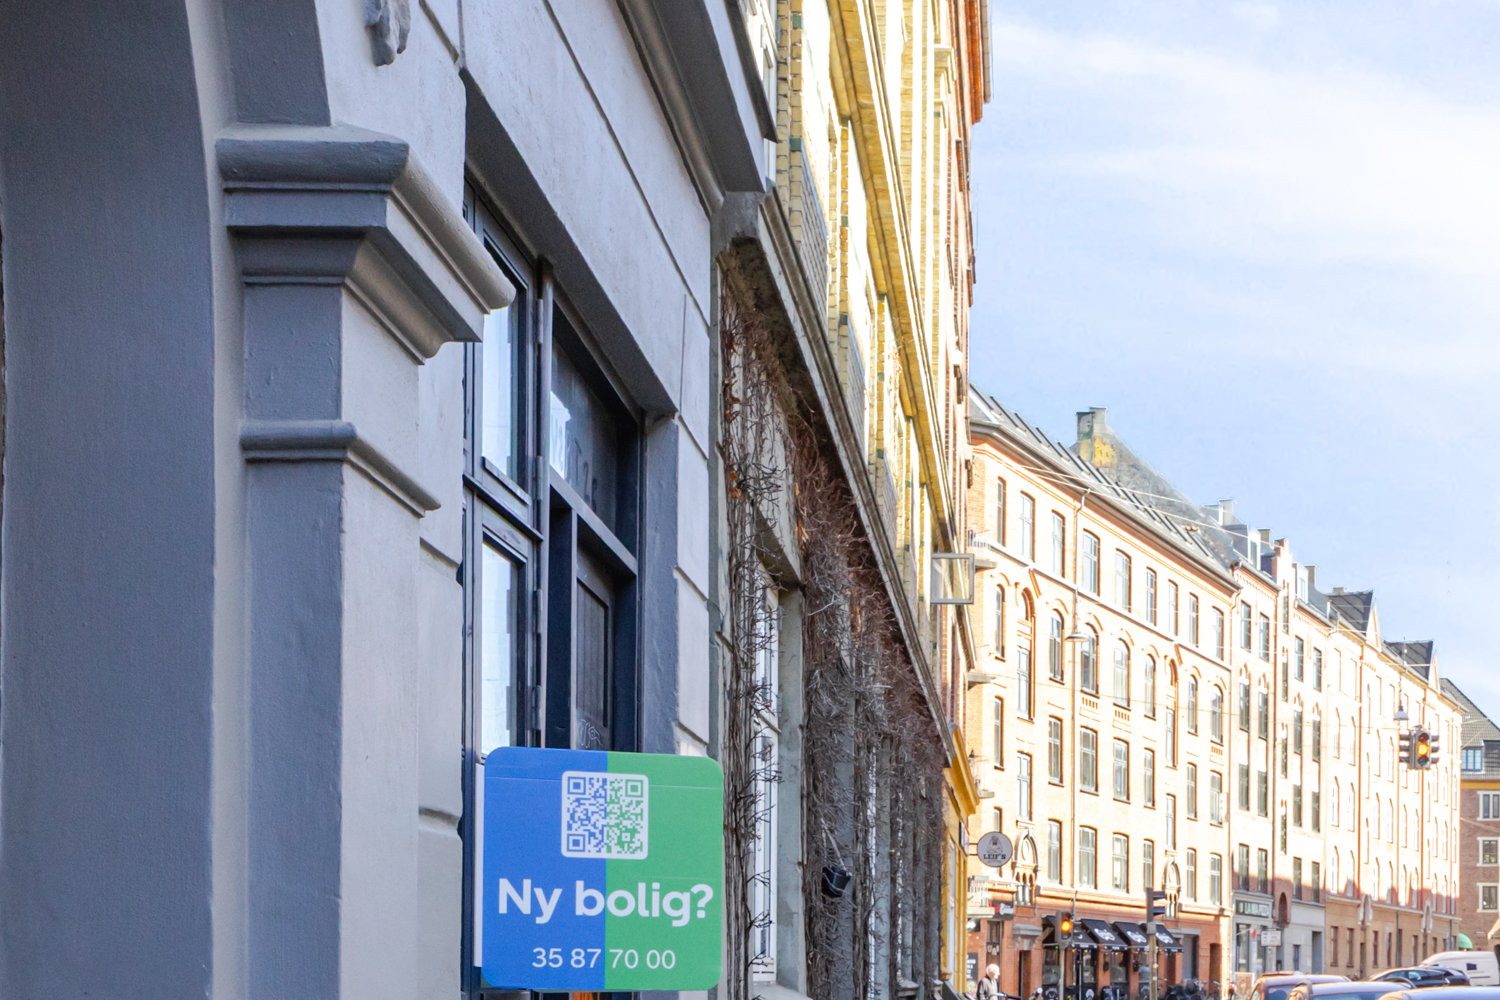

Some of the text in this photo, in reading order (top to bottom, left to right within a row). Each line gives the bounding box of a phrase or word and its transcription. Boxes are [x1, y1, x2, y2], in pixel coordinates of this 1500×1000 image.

[498, 878, 714, 927] Ny bolig?
[532, 948, 676, 969] 35 87 70 00
